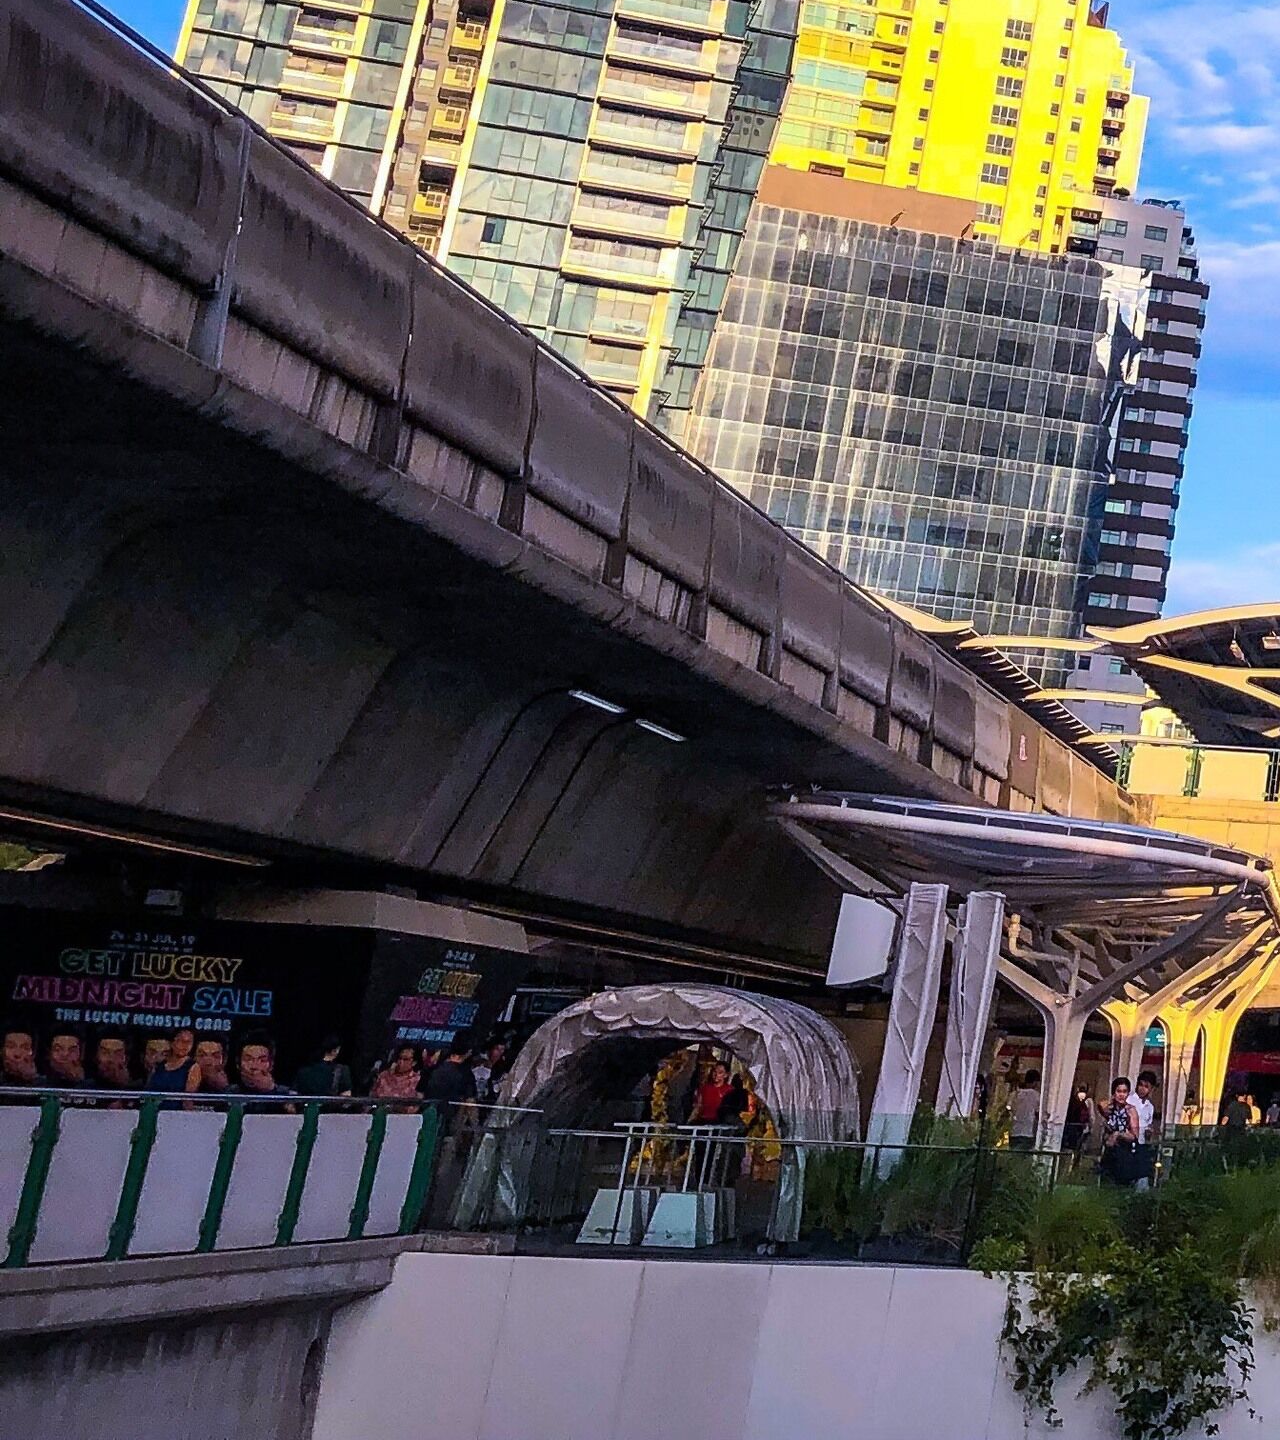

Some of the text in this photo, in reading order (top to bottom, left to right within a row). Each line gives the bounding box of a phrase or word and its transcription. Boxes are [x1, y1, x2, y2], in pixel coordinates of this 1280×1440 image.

[59, 947, 243, 984] GET LUCKY
[12, 974, 273, 1016] MIDNIGHT SALE
[55, 1008, 81, 1022] THE
[84, 1009, 130, 1025] LUCKY
